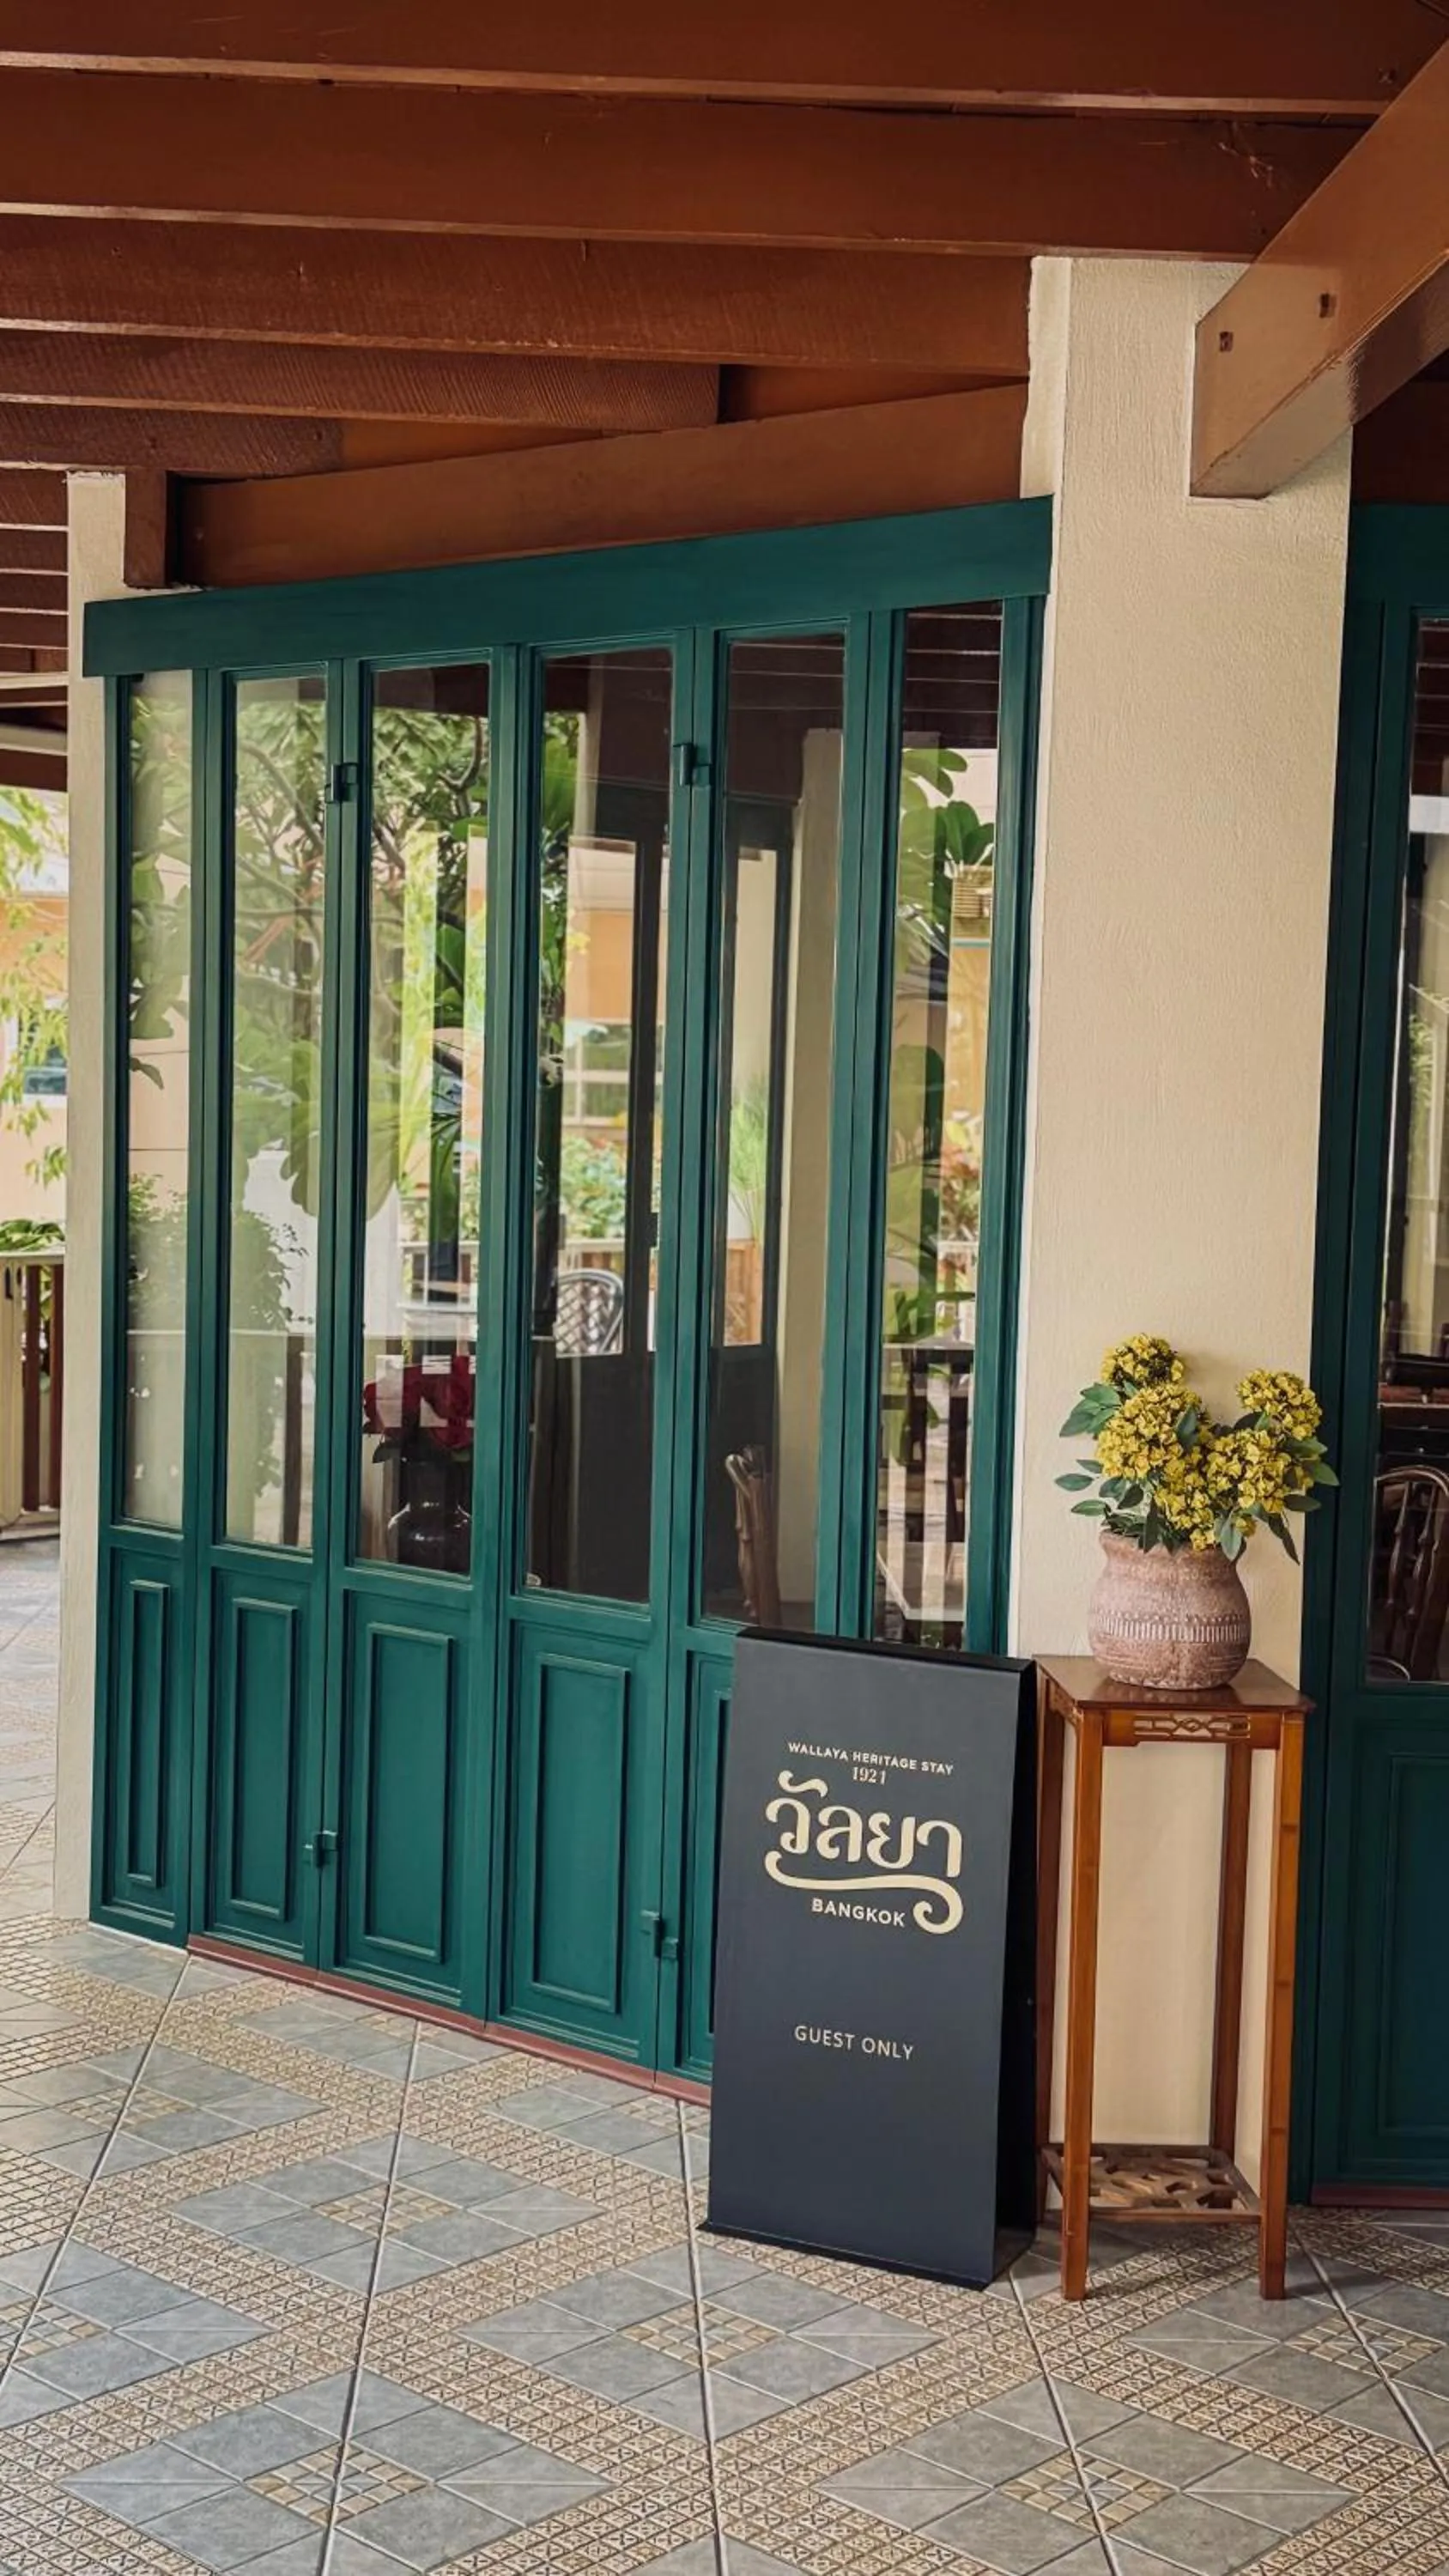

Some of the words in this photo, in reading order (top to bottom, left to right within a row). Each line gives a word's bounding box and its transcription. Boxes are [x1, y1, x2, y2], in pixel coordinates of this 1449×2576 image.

[788, 1741, 848, 1761] WALLAYA
[852, 1751, 918, 1770] HERITAGE
[921, 1761, 954, 1776] STAY
[852, 1766, 886, 1785] 1921
[765, 1770, 962, 1878] วัลยา
[811, 1897, 906, 1927] BANGKOK
[794, 2025, 855, 2050] GUEST
[861, 2037, 913, 2060] ONLY
